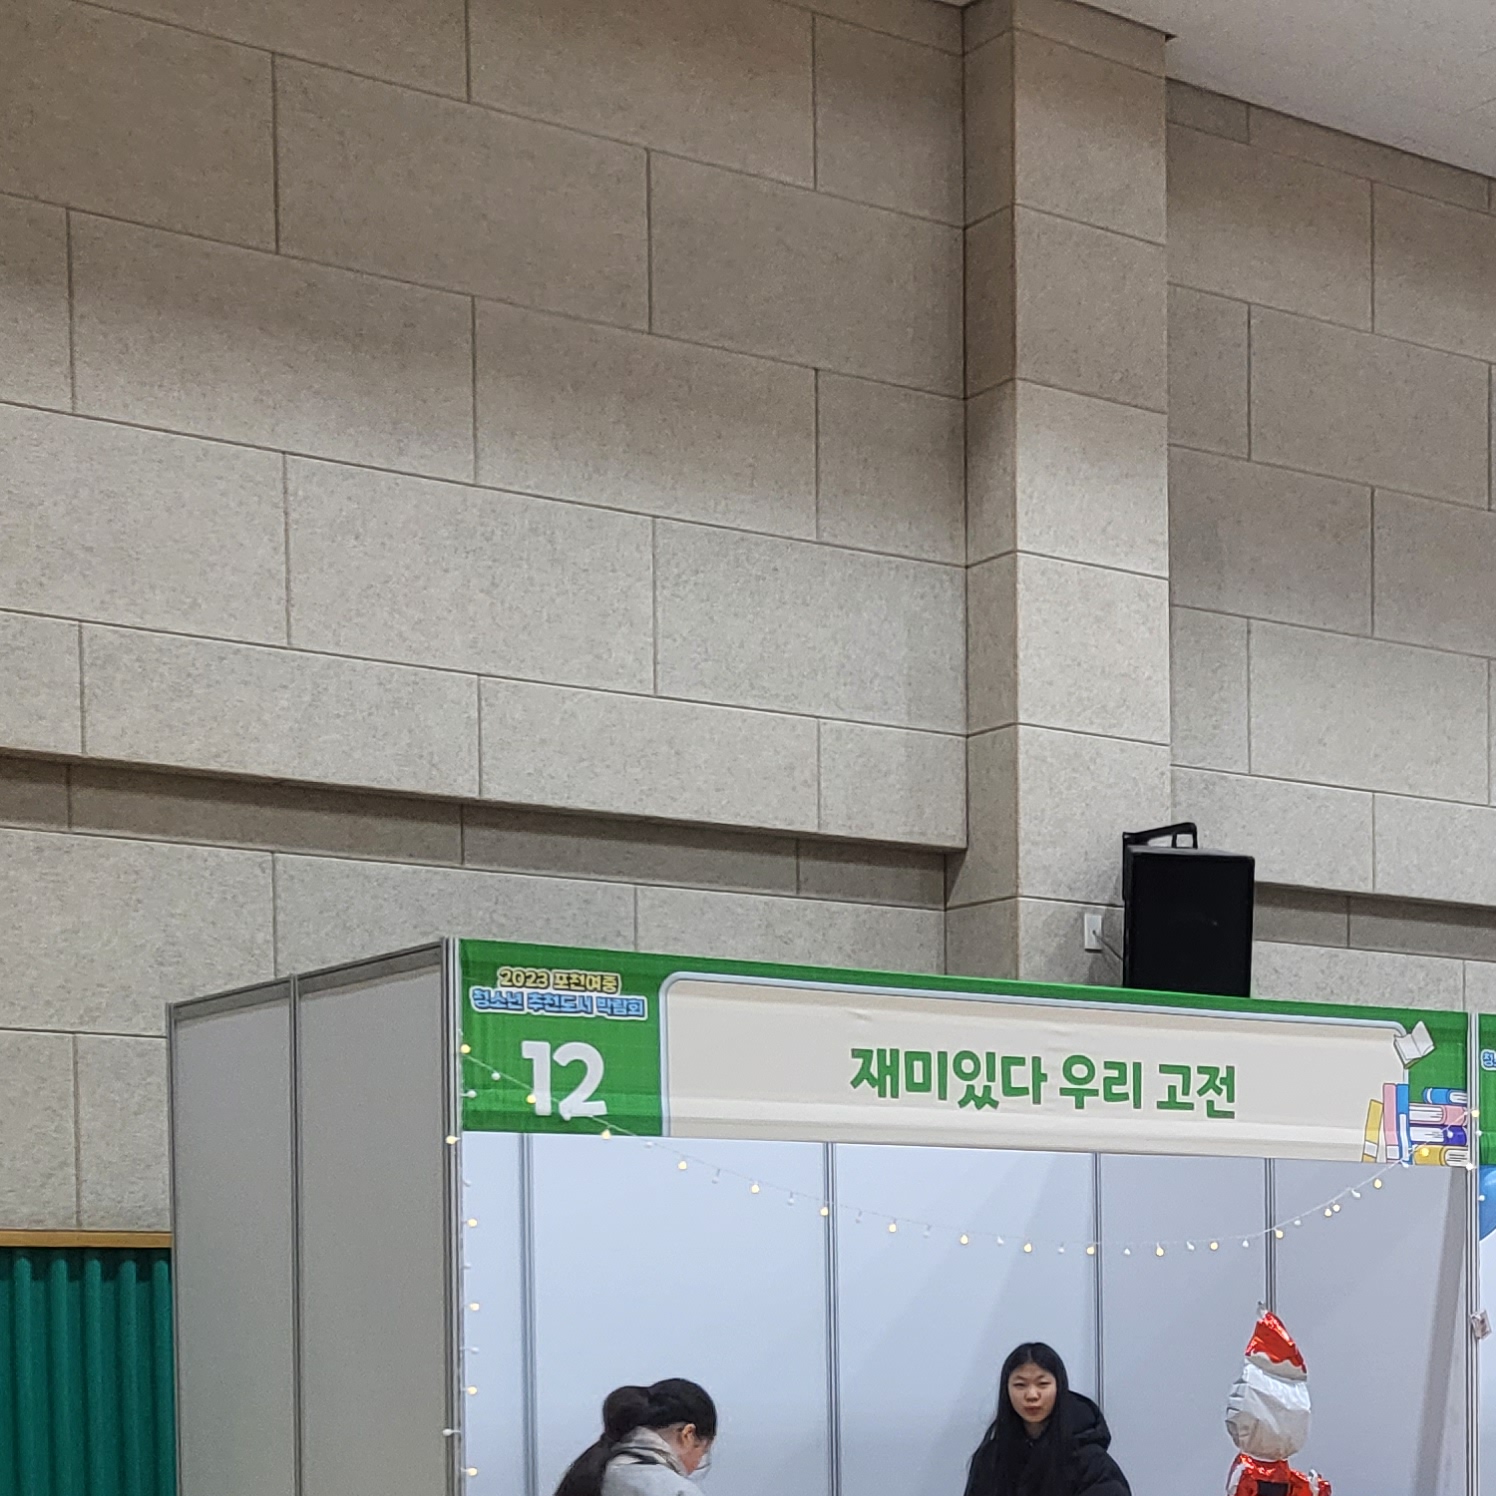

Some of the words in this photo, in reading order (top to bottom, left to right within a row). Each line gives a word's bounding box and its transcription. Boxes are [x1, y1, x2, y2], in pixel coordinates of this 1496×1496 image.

[498, 967, 550, 988] 2023
[521, 1040, 608, 1121] 12
[850, 1047, 1048, 1109] 재미있다
[1059, 1054, 1142, 1110] 우리
[1156, 1063, 1236, 1119] 고전
